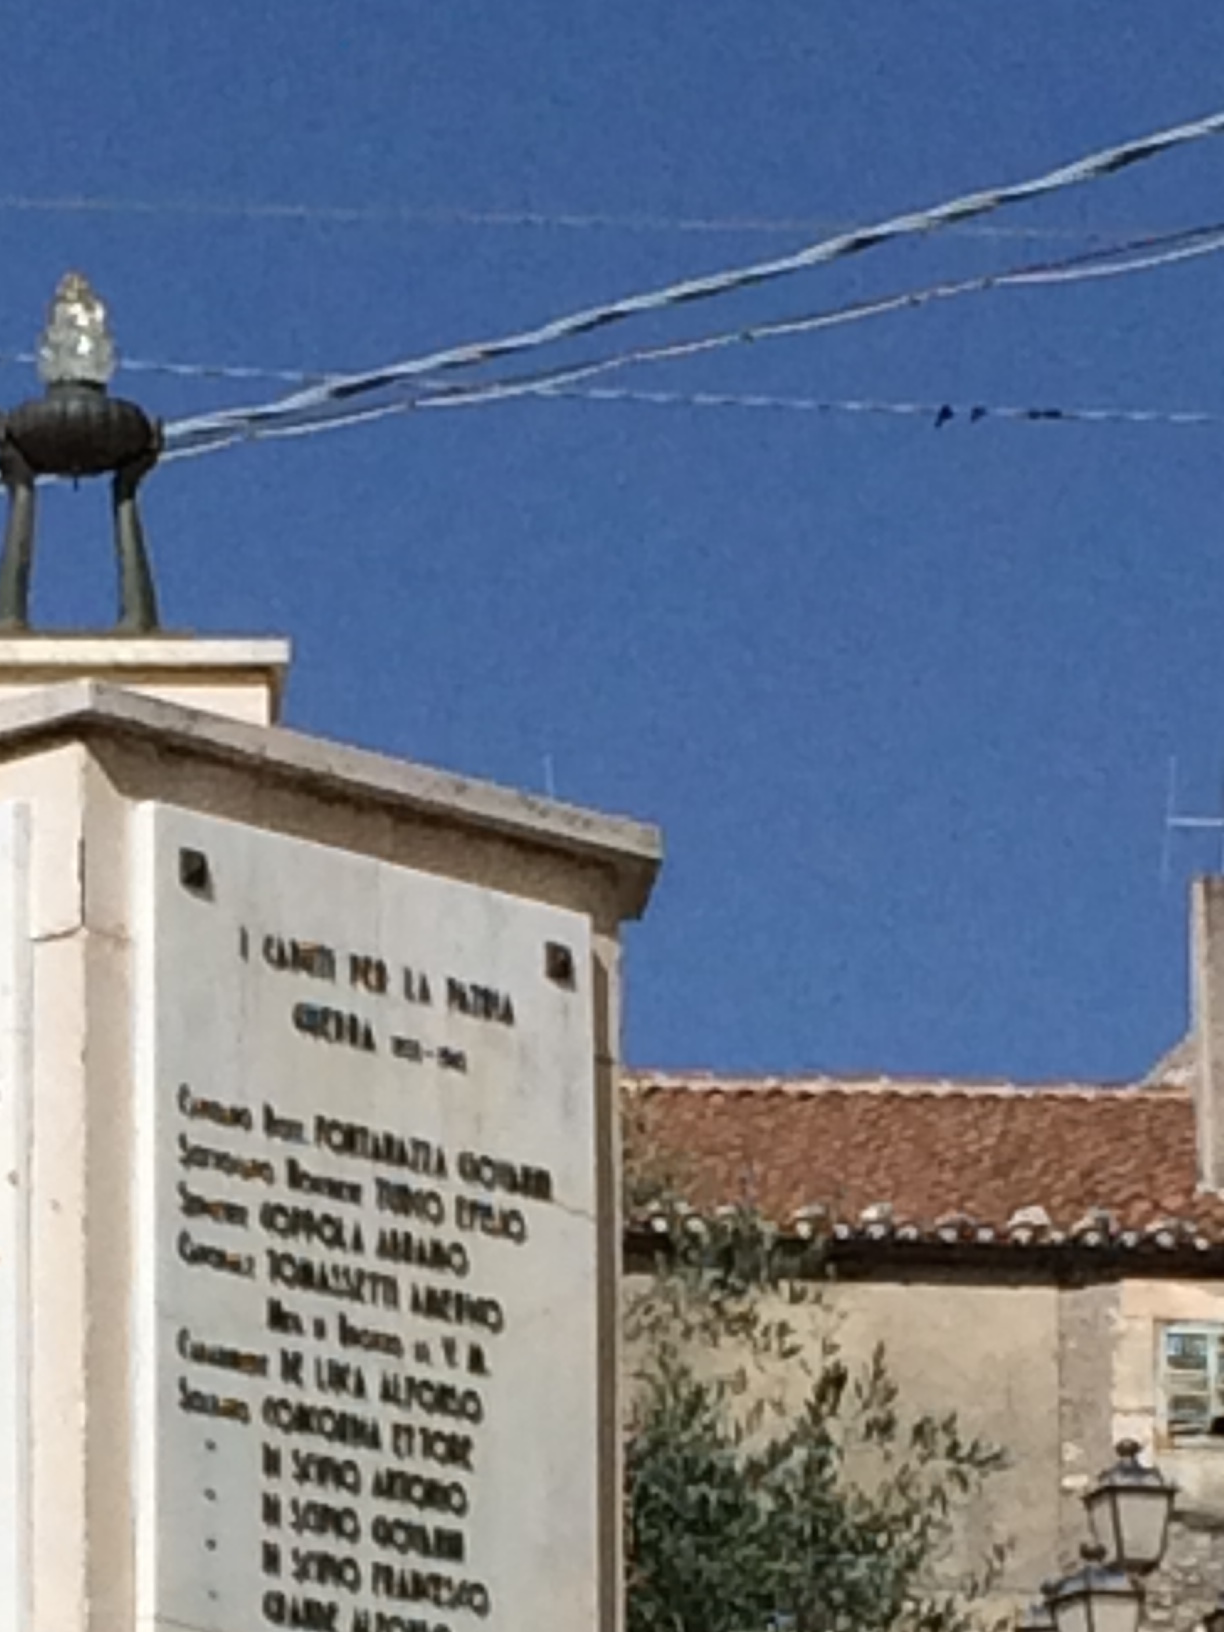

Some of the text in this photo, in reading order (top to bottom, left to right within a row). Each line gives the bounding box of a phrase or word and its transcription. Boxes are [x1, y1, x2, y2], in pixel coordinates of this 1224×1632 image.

[348, 953, 388, 995] PER
[403, 966, 431, 1005] LA
[445, 976, 514, 1026] PATRIA
[291, 1002, 376, 1053] GUERRA
[258, 1202, 363, 1252] COPPOLA
[266, 1249, 399, 1309] TOMASSETTI
